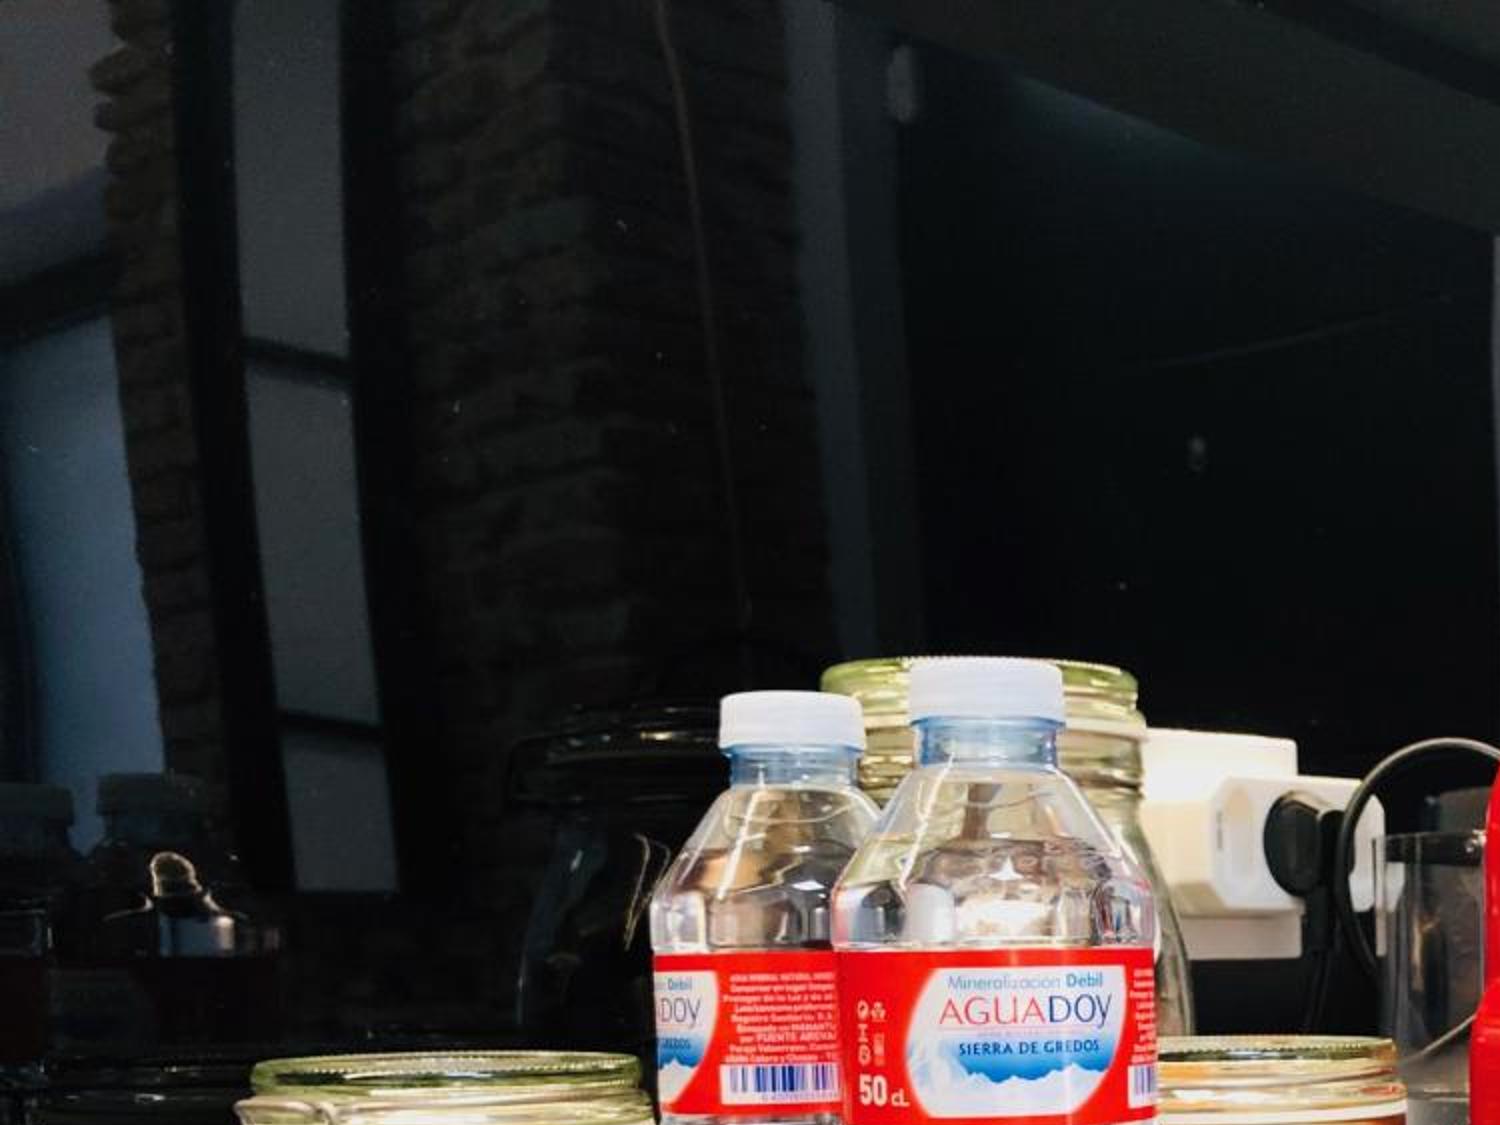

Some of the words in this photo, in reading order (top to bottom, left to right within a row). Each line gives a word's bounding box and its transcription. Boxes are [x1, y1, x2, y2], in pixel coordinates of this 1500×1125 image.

[939, 993, 1112, 1029] AGUADOY
[959, 1040, 1013, 1056] SIERRA
[1019, 1041, 1038, 1055] DE
[1043, 1038, 1100, 1054] GREDOS
[859, 1074, 888, 1107] 50
